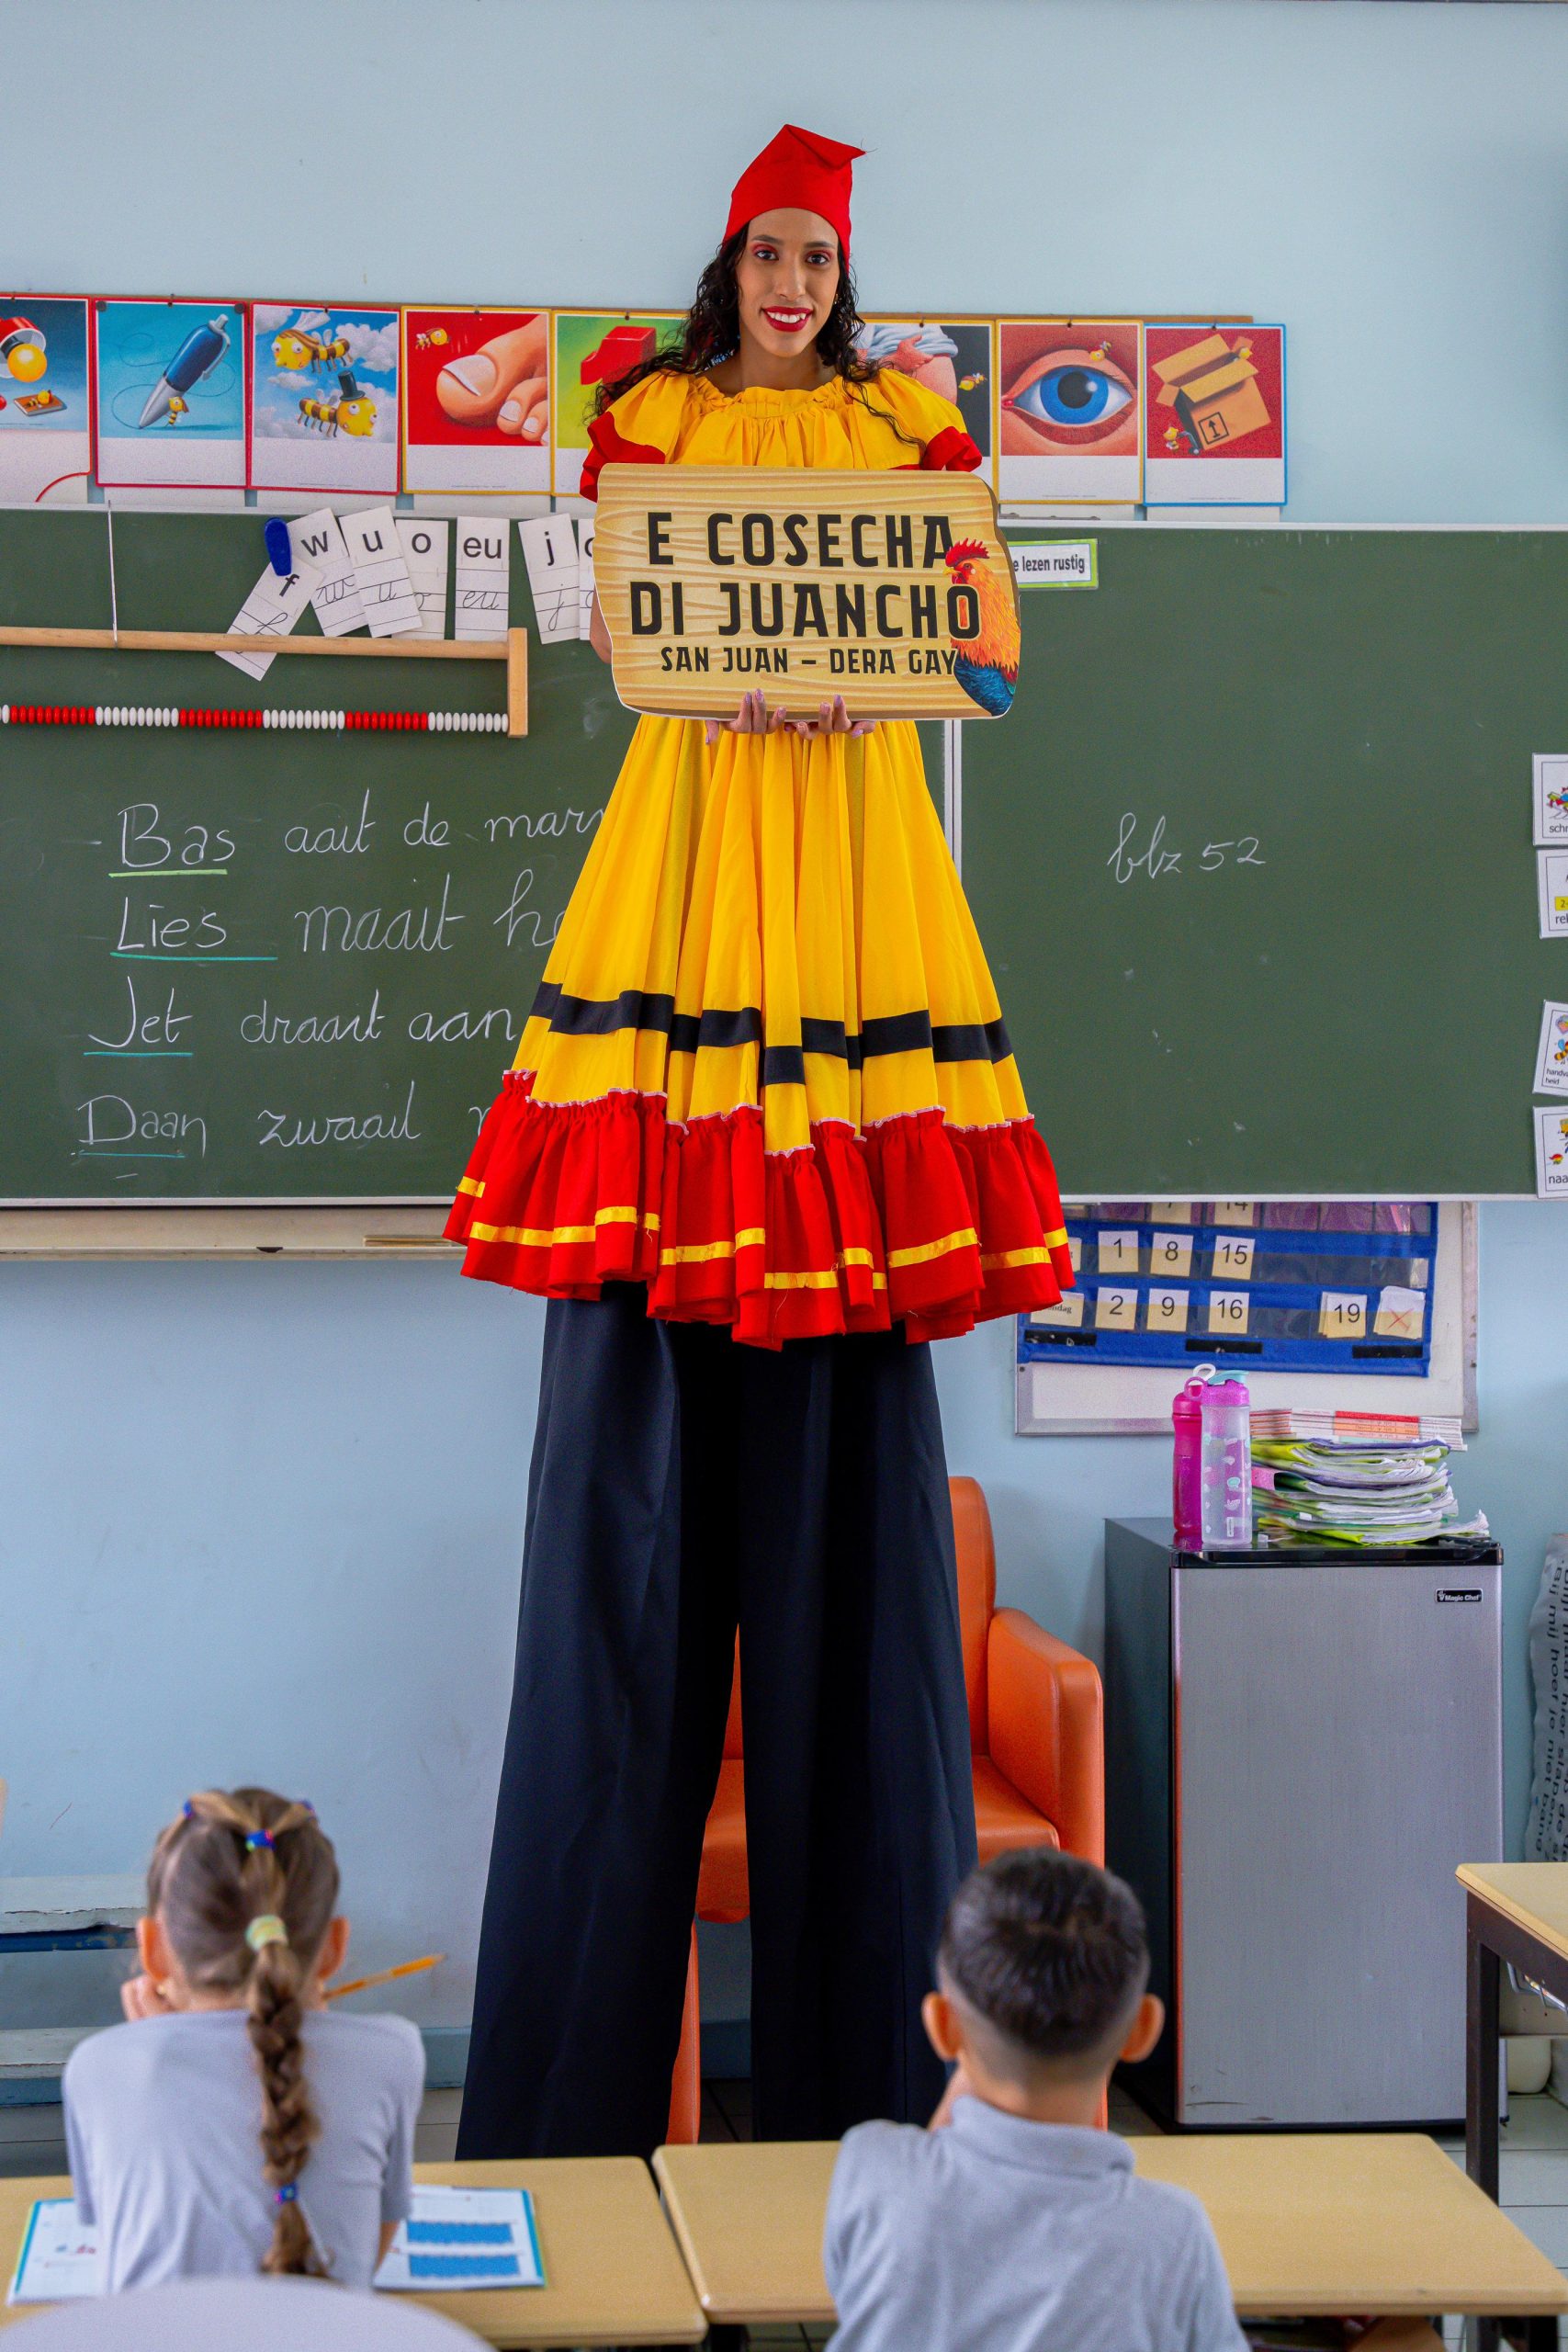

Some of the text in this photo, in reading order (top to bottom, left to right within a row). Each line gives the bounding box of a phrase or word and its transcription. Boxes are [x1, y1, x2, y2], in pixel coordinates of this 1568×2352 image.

[300, 530, 329, 557] w
[362, 530, 383, 552] u
[412, 533, 432, 553] o
[463, 537, 502, 559] eu
[544, 531, 555, 566] j
[648, 512, 953, 568] E COSECHA
[1022, 556, 1050, 571] lezen
[1054, 554, 1085, 574] rustig
[279, 573, 299, 596] f
[630, 581, 980, 639] DI JUANCHO
[661, 646, 709, 673] SAN
[723, 647, 788, 673] JUAN
[830, 648, 896, 675] DERA
[908, 649, 958, 675] GAY
[118, 803, 235, 867] Bas
[403, 801, 450, 846] de
[1200, 836, 1267, 871] 52
[117, 896, 228, 951] Lies
[88, 976, 193, 1047] Jet
[77, 1094, 207, 1158] Daan
[1112, 1238, 1122, 1258] 1
[1165, 1240, 1179, 1261] 8
[1222, 1243, 1248, 1264] 15
[1109, 1295, 1124, 1315] 2
[1161, 1296, 1175, 1317] 9
[1217, 1298, 1244, 1318] 16
[1334, 1303, 1360, 1323] 19
